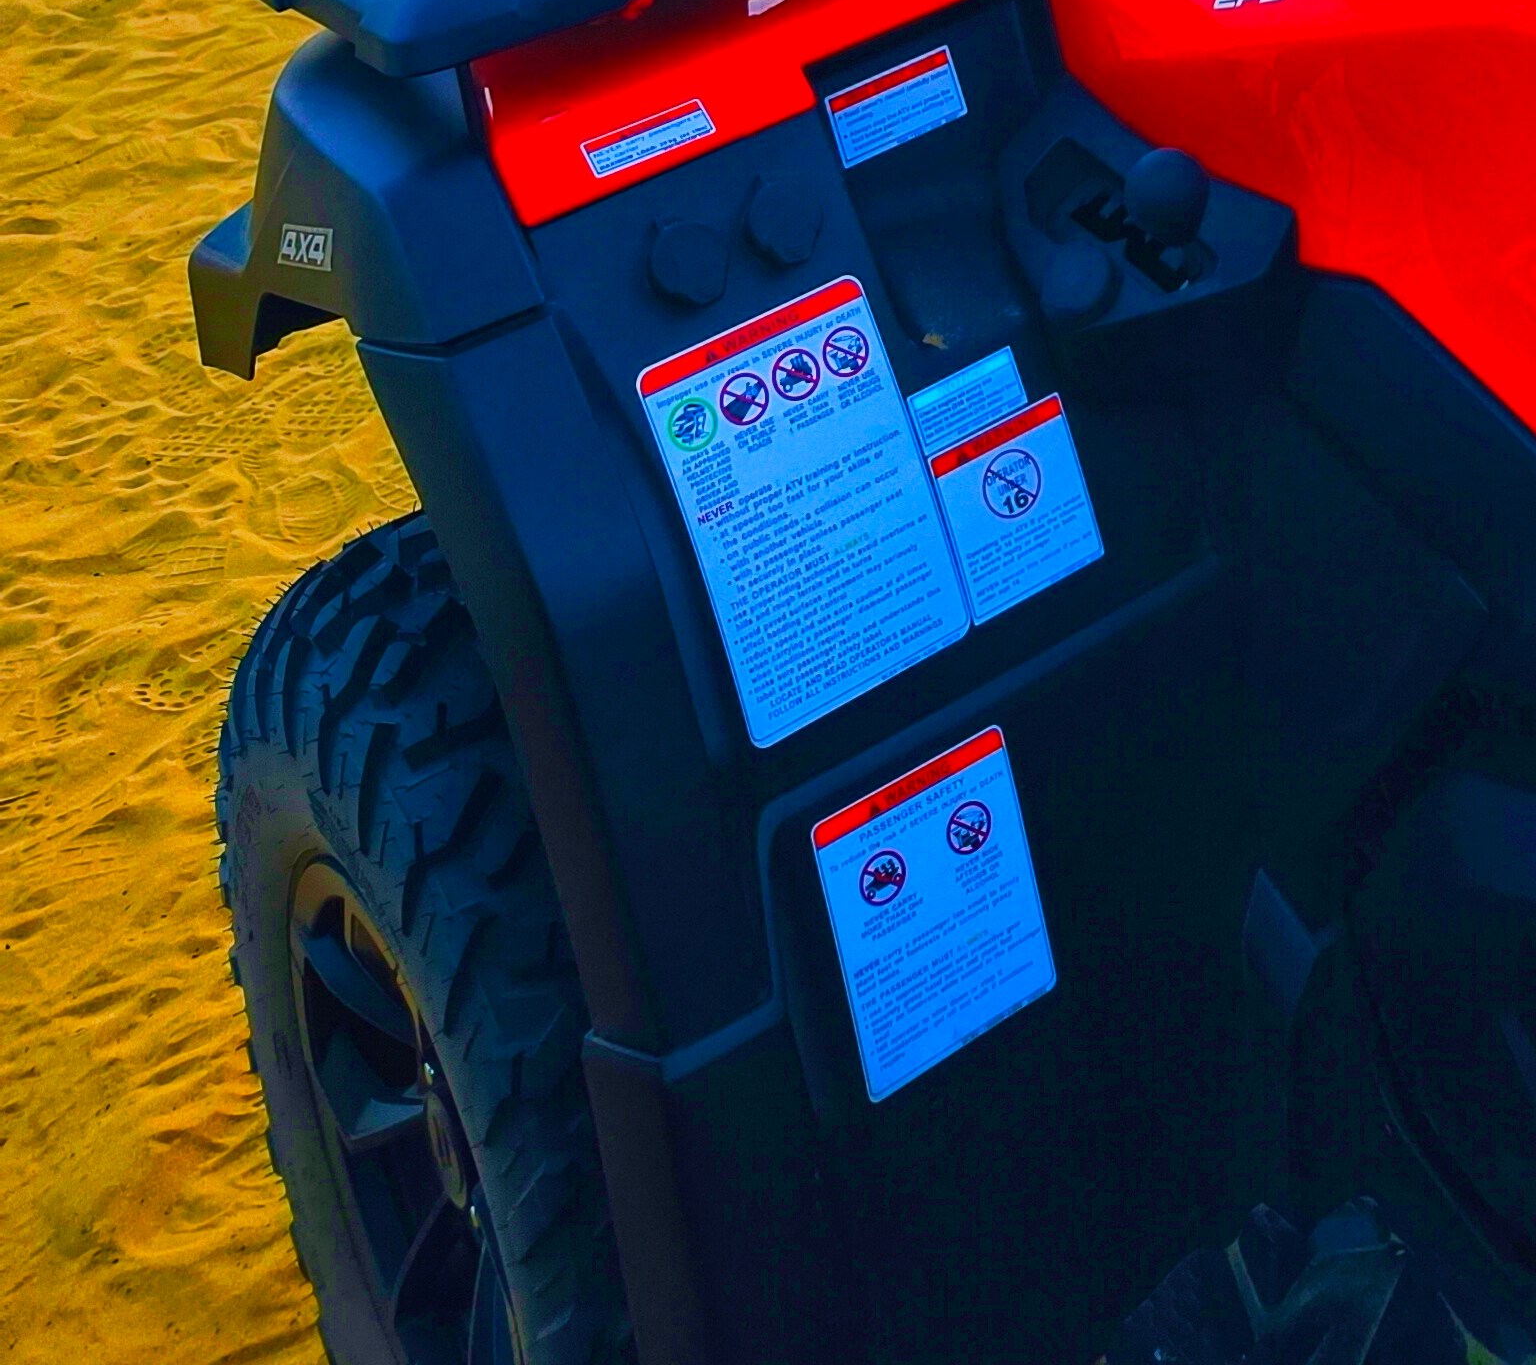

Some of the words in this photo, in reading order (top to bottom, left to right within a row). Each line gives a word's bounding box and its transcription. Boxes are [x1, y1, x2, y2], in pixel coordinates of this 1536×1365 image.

[784, 476, 803, 492] ATV
[696, 500, 733, 525] NEVER
[1001, 486, 1030, 516] 16
[751, 567, 802, 600] OPERATOR
[859, 799, 922, 843] PASSENGER
[925, 775, 964, 805] SAFETY
